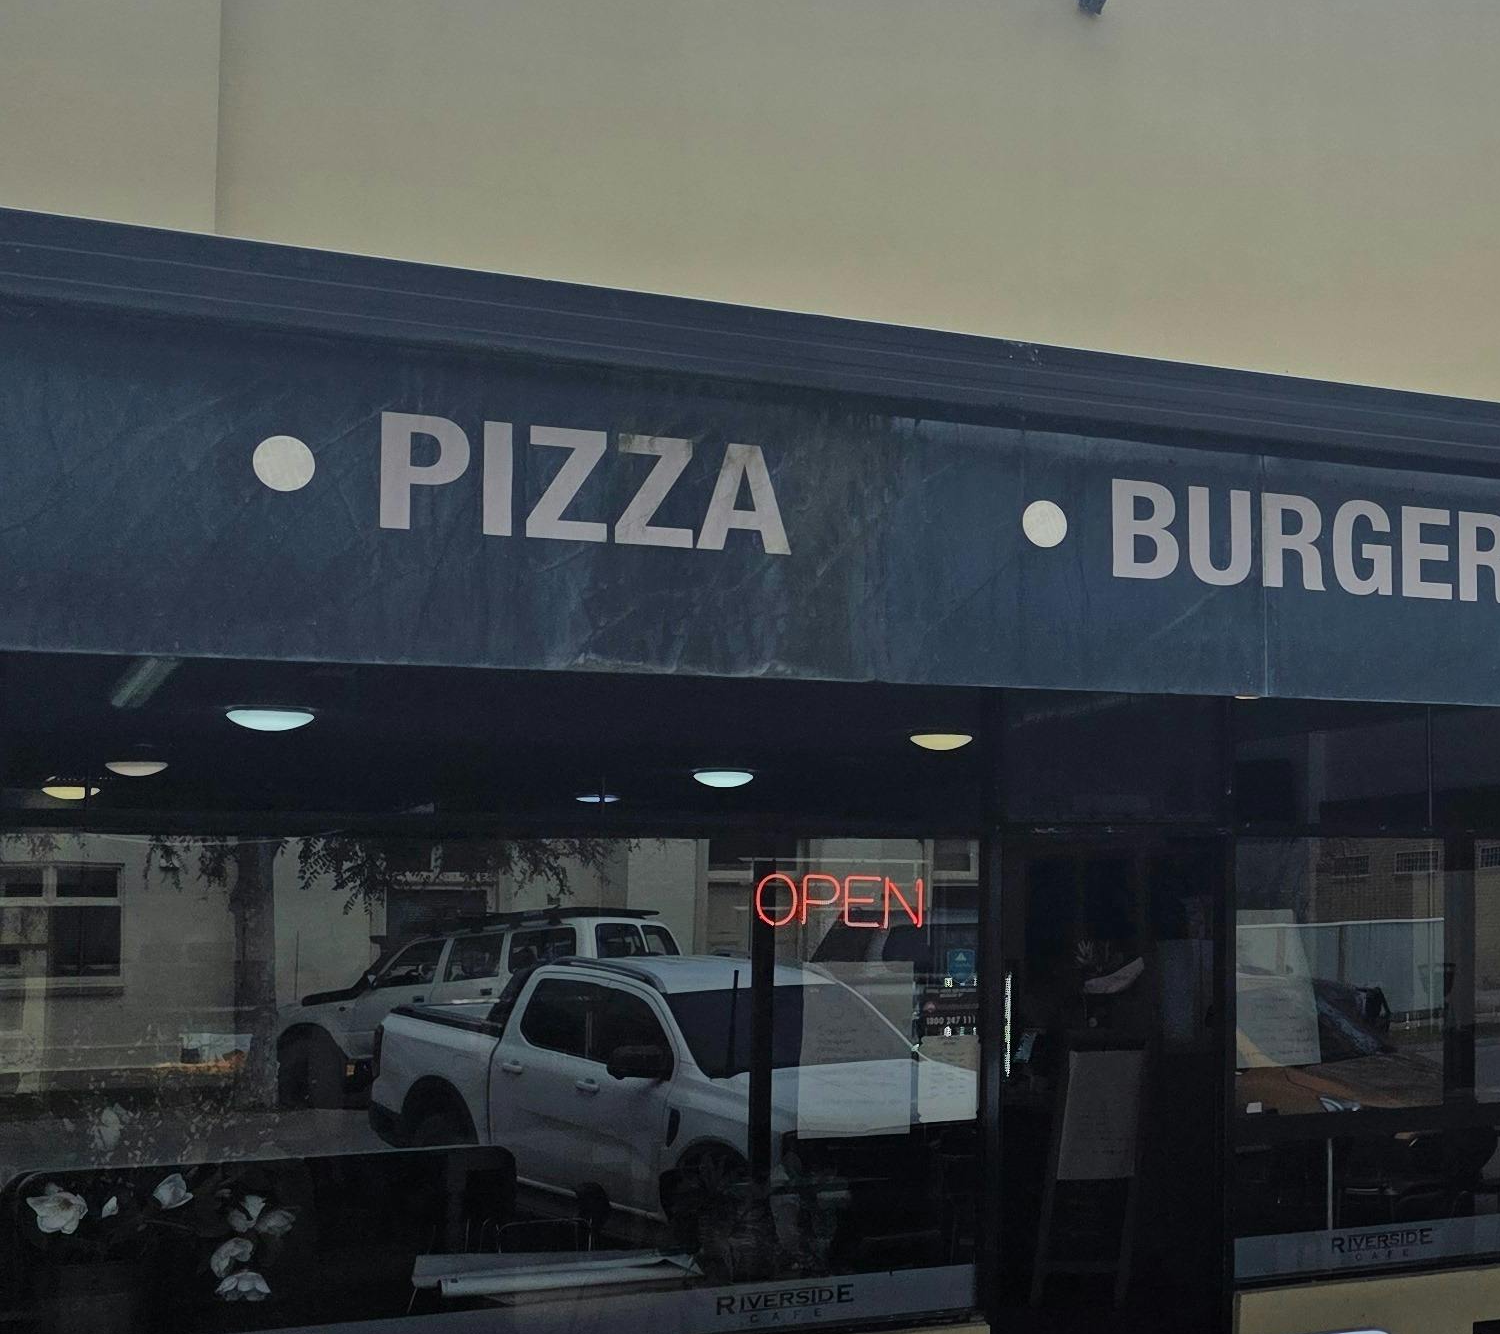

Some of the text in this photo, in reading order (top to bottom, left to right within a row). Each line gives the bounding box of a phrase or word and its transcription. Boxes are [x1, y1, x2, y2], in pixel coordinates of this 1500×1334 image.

[379, 410, 792, 556] PIZZA
[755, 873, 924, 930] OPEN
[1331, 1228, 1433, 1253] RIVERSIDE
[716, 1283, 855, 1316] RIVERSIDE
[750, 1307, 823, 1324] CAFE
